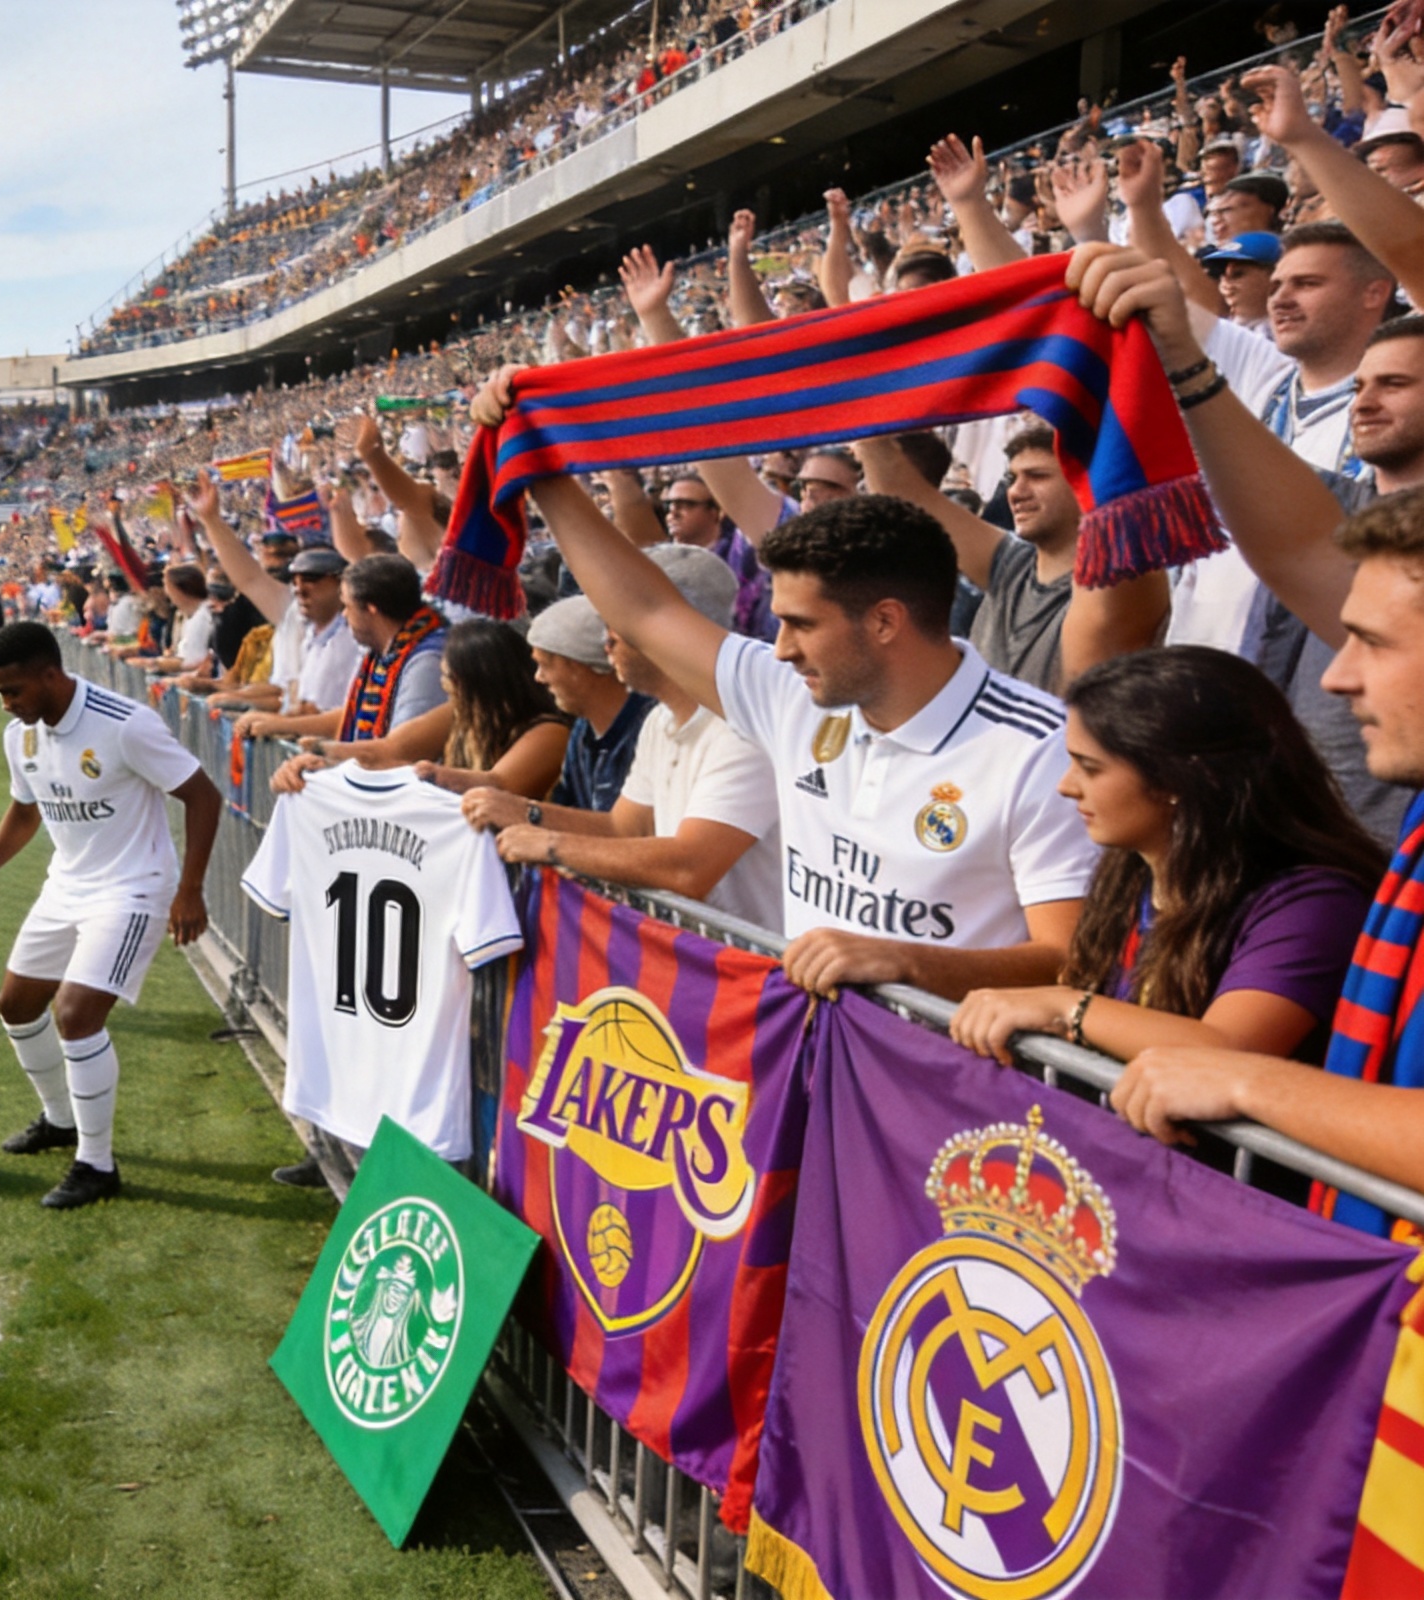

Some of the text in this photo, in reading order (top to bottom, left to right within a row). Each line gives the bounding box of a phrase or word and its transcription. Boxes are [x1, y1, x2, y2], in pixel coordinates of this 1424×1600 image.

[786, 845, 955, 940] Emirates
[832, 833, 881, 884] Fly
[325, 870, 422, 1028] 10
[521, 1017, 750, 1220] LAKERS
